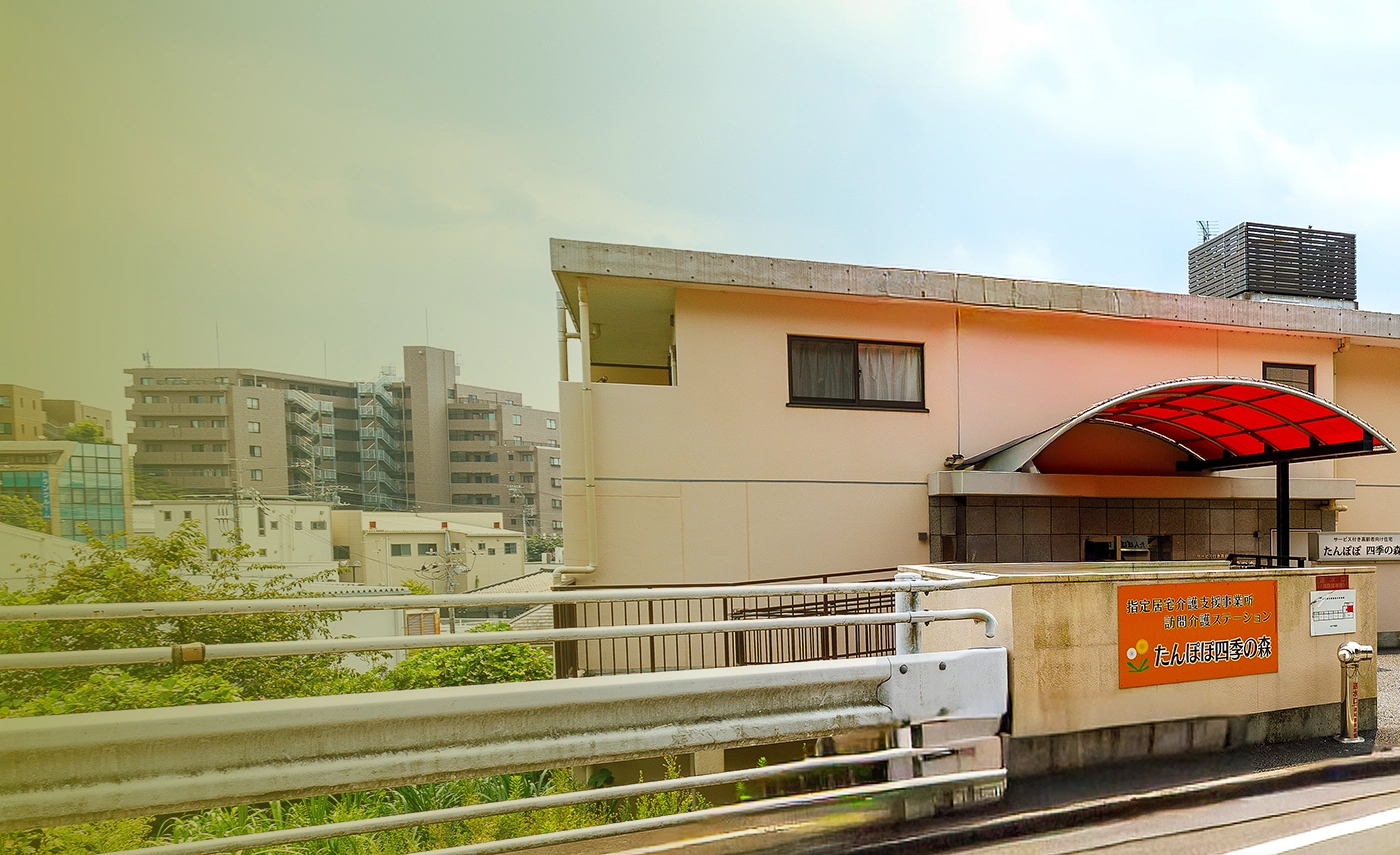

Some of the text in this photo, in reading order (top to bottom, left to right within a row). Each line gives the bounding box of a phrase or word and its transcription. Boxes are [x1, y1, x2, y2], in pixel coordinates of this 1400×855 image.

[1323, 545, 1362, 556] たんぽぽ
[1126, 594, 1254, 614] 指定居宅介護支援事業所
[1163, 611, 1272, 630] 訪問介護ステーション
[1154, 635, 1272, 667] たんぽぽ四季の森
